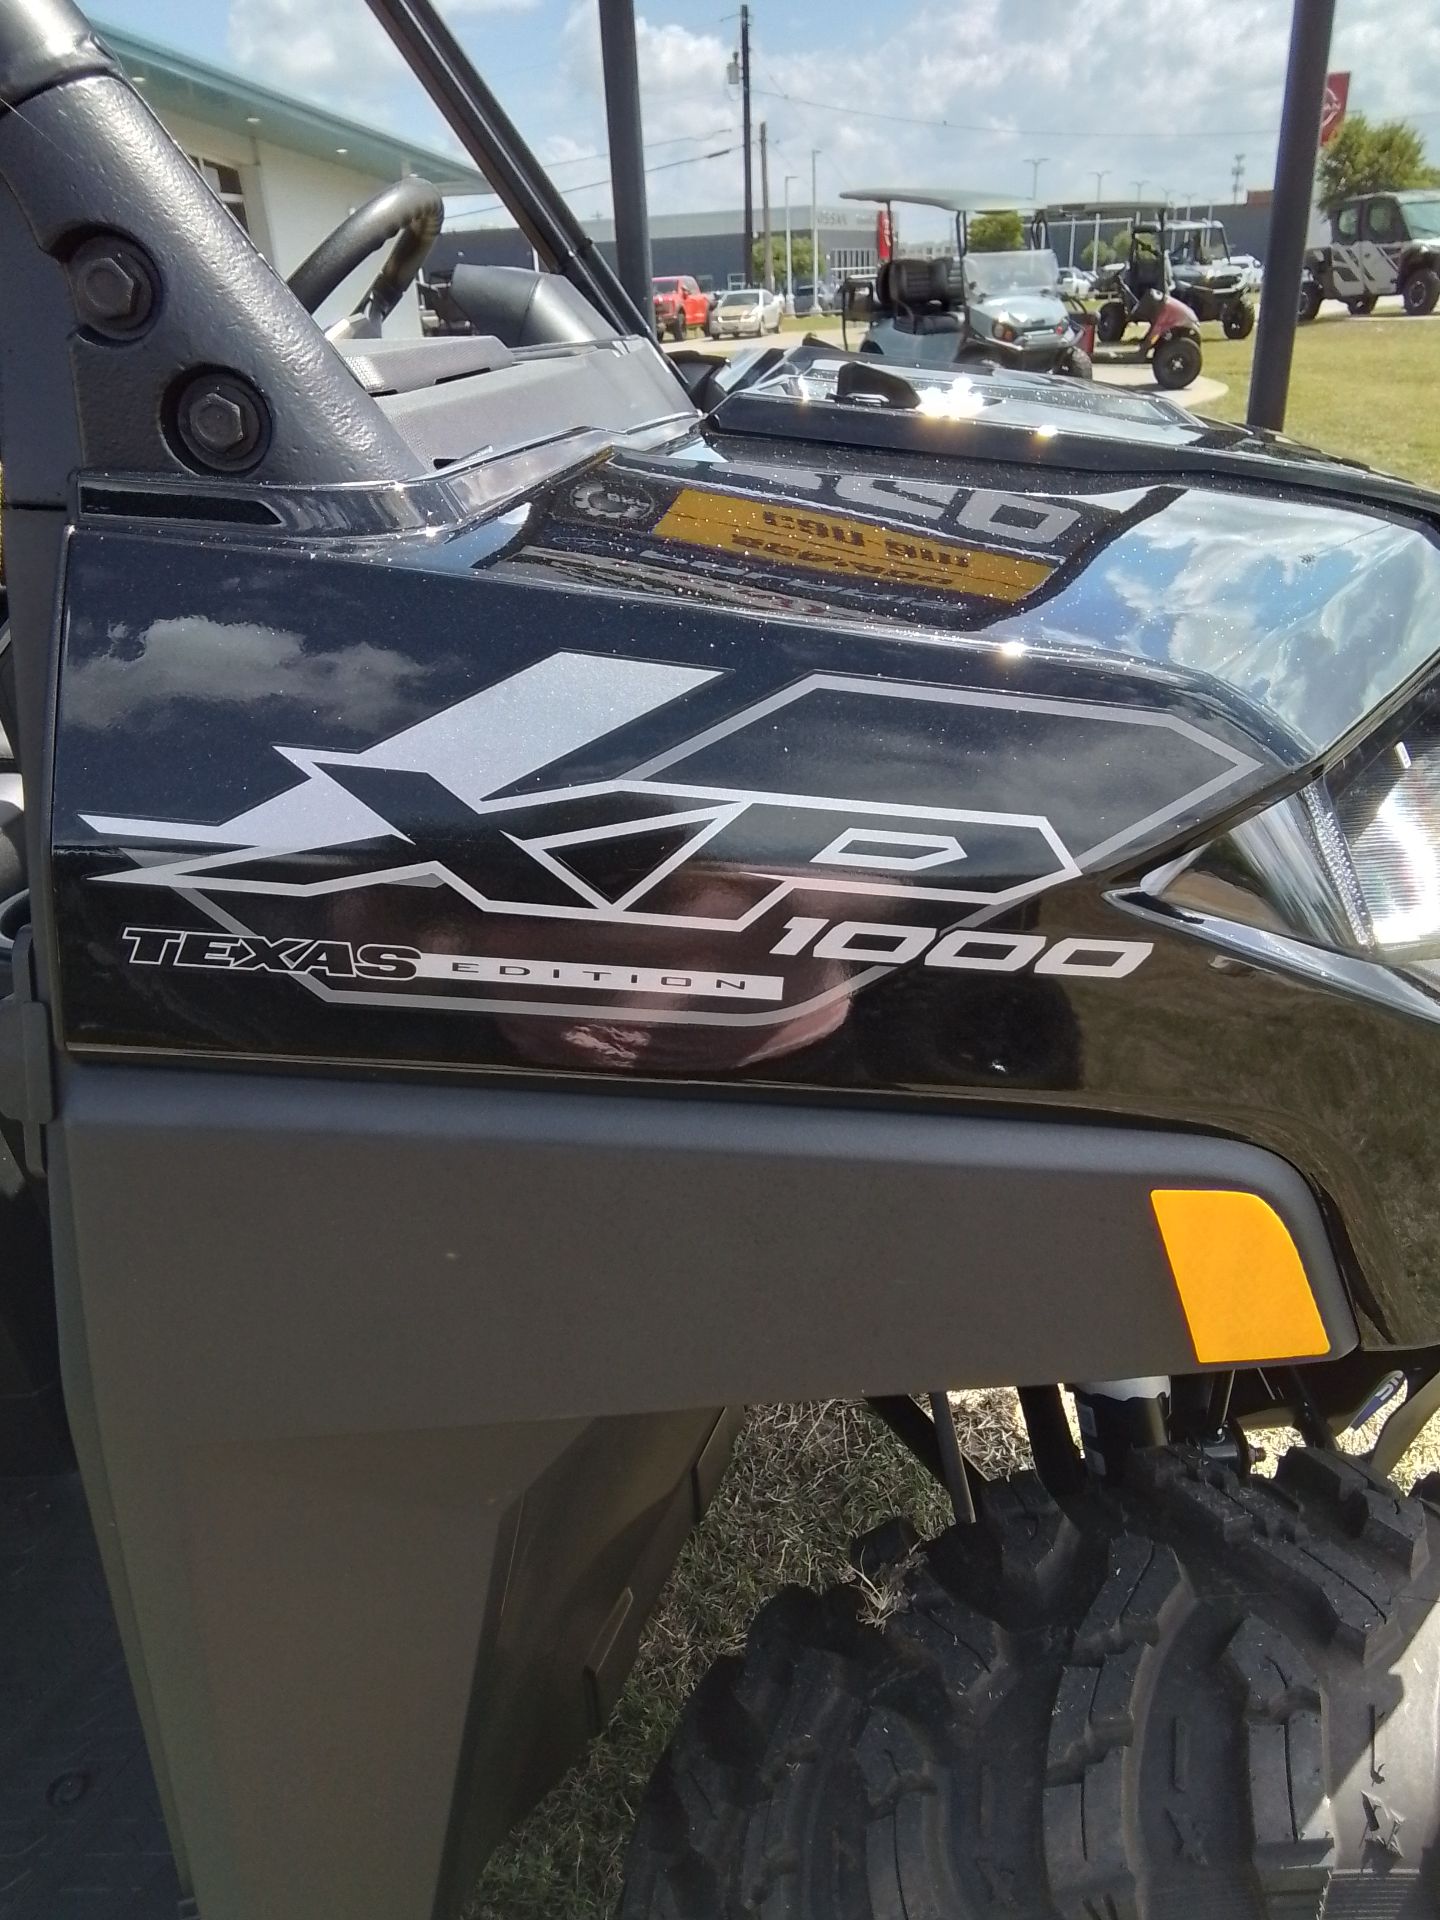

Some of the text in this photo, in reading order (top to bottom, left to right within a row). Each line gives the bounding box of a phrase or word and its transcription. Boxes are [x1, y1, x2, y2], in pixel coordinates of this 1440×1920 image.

[122, 927, 747, 991] TEXAS EDITION
[769, 916, 1154, 979] 1000
